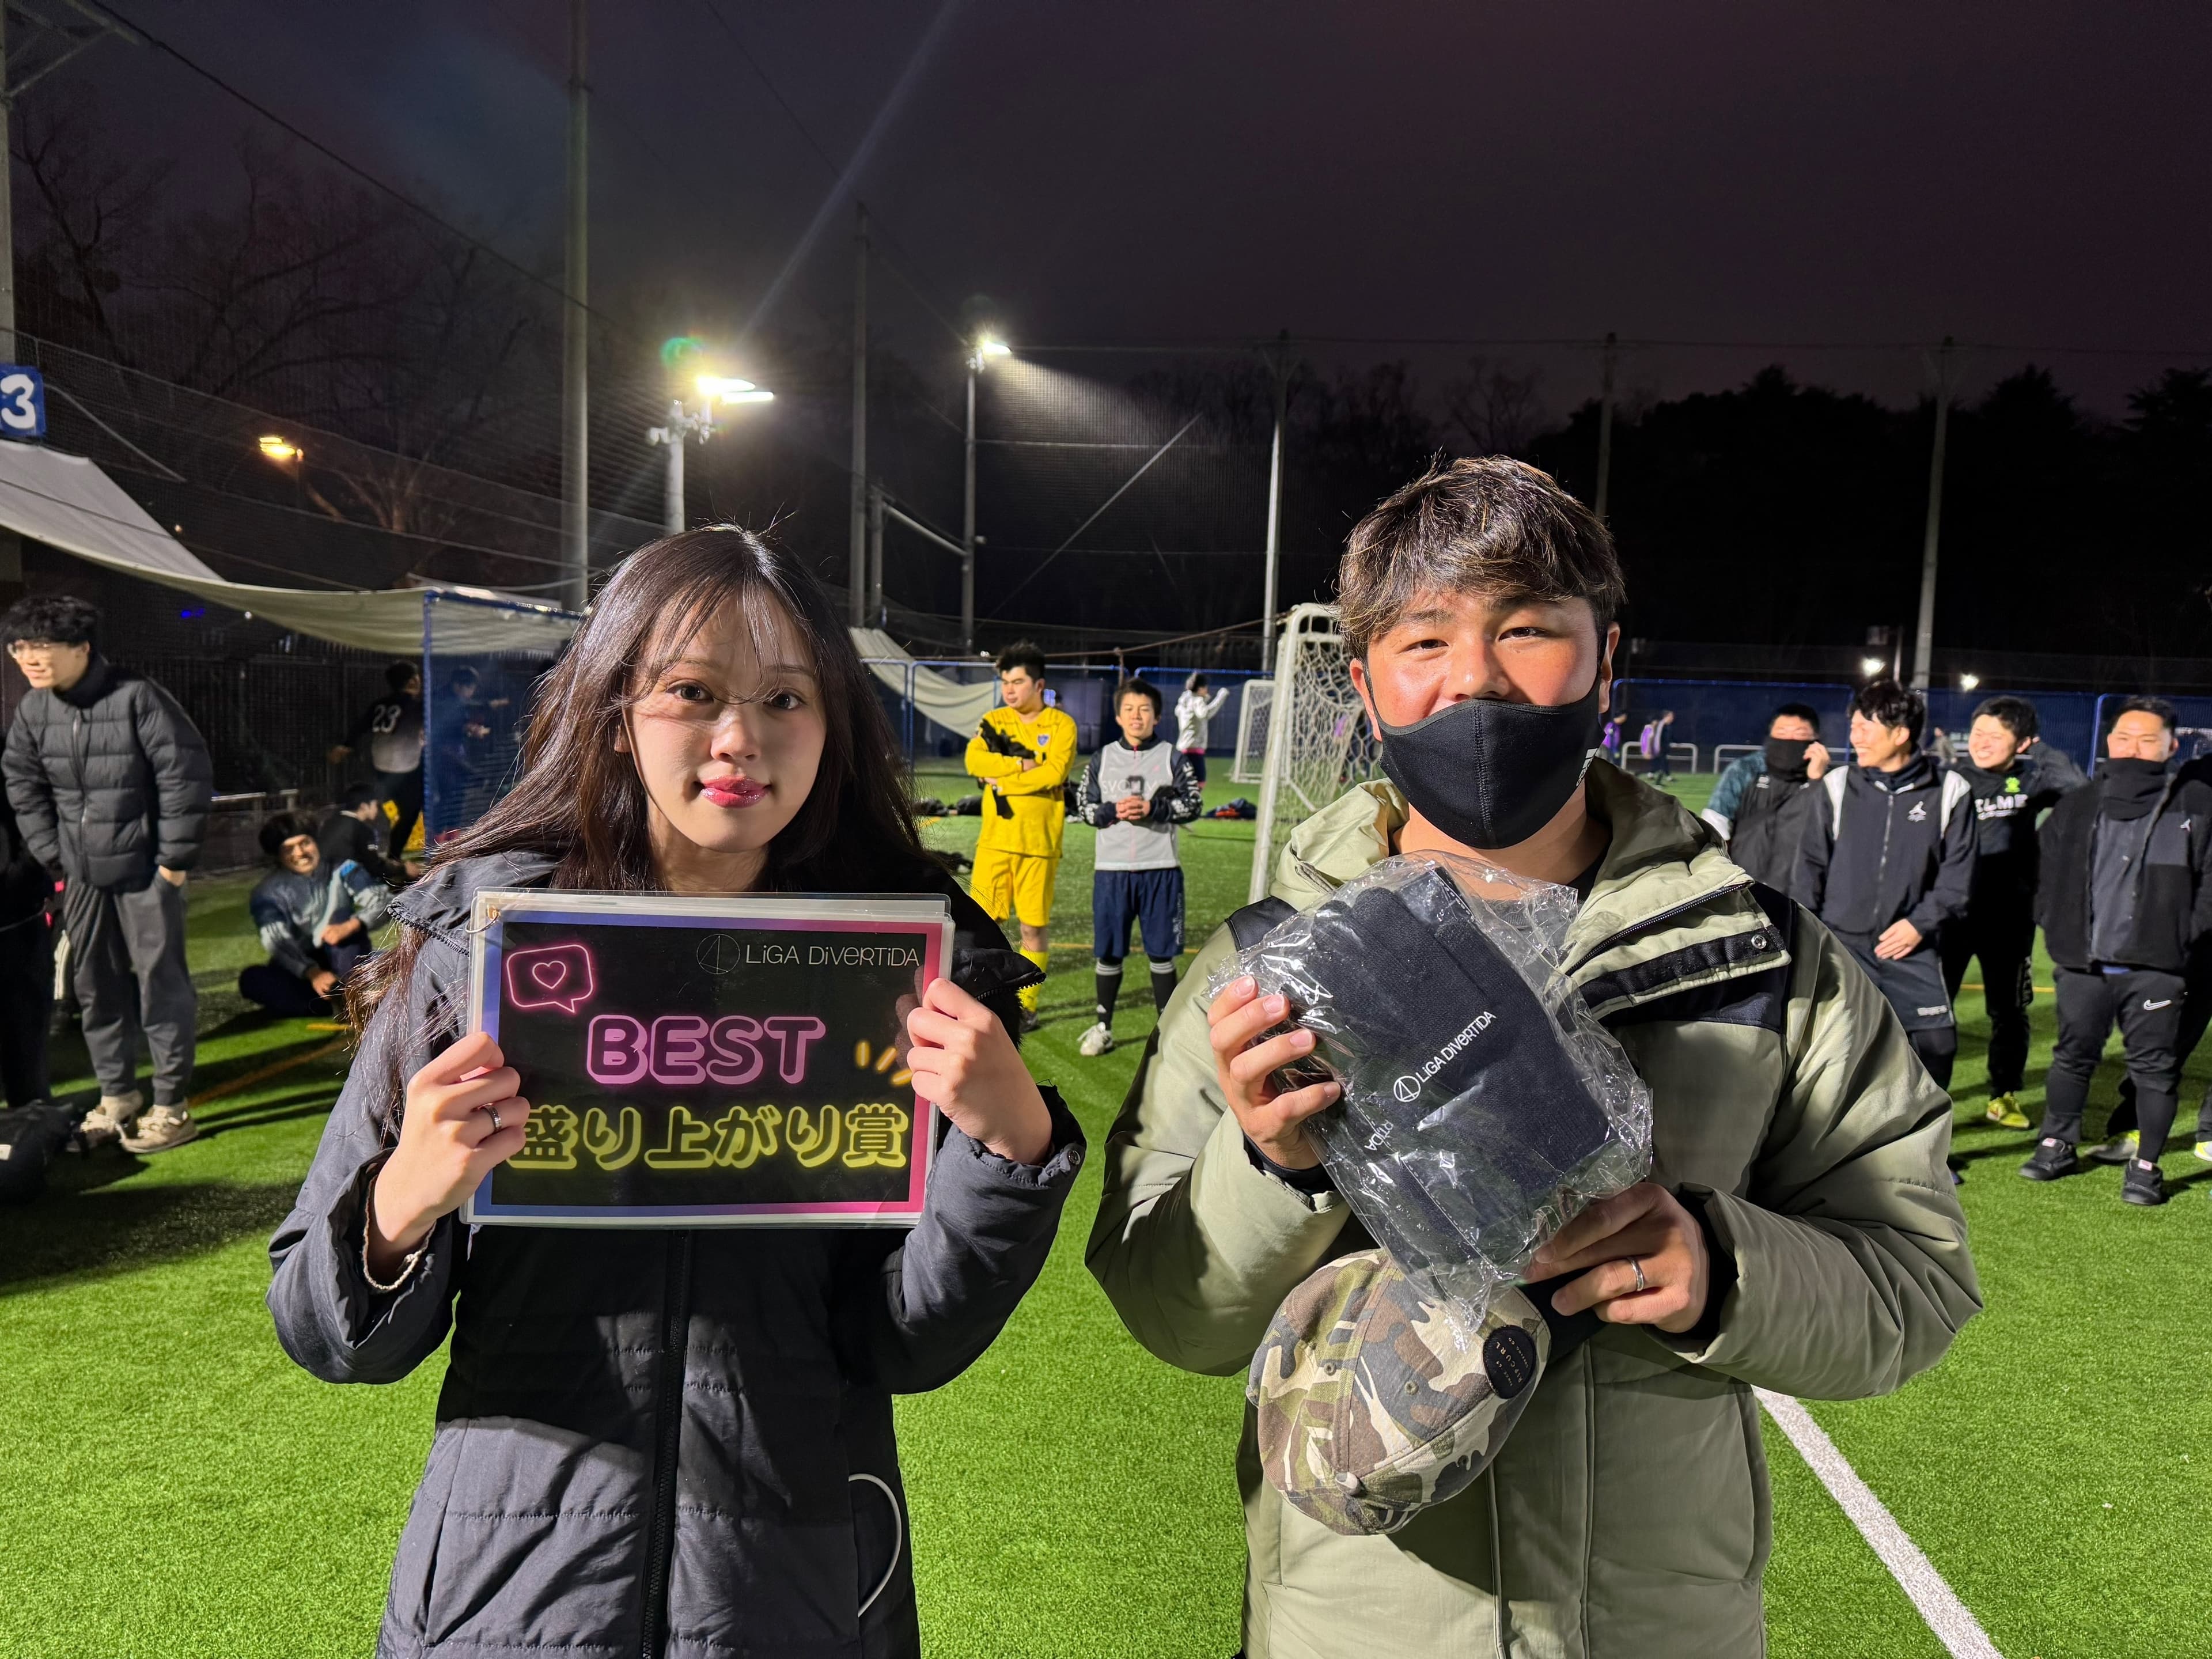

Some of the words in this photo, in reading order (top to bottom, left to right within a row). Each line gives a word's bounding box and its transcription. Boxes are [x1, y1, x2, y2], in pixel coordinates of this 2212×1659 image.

[0, 374, 36, 429] 3
[372, 704, 402, 733] 23
[586, 1014, 827, 1085] BEST
[506, 1103, 910, 1171] 盛り上がり賞
